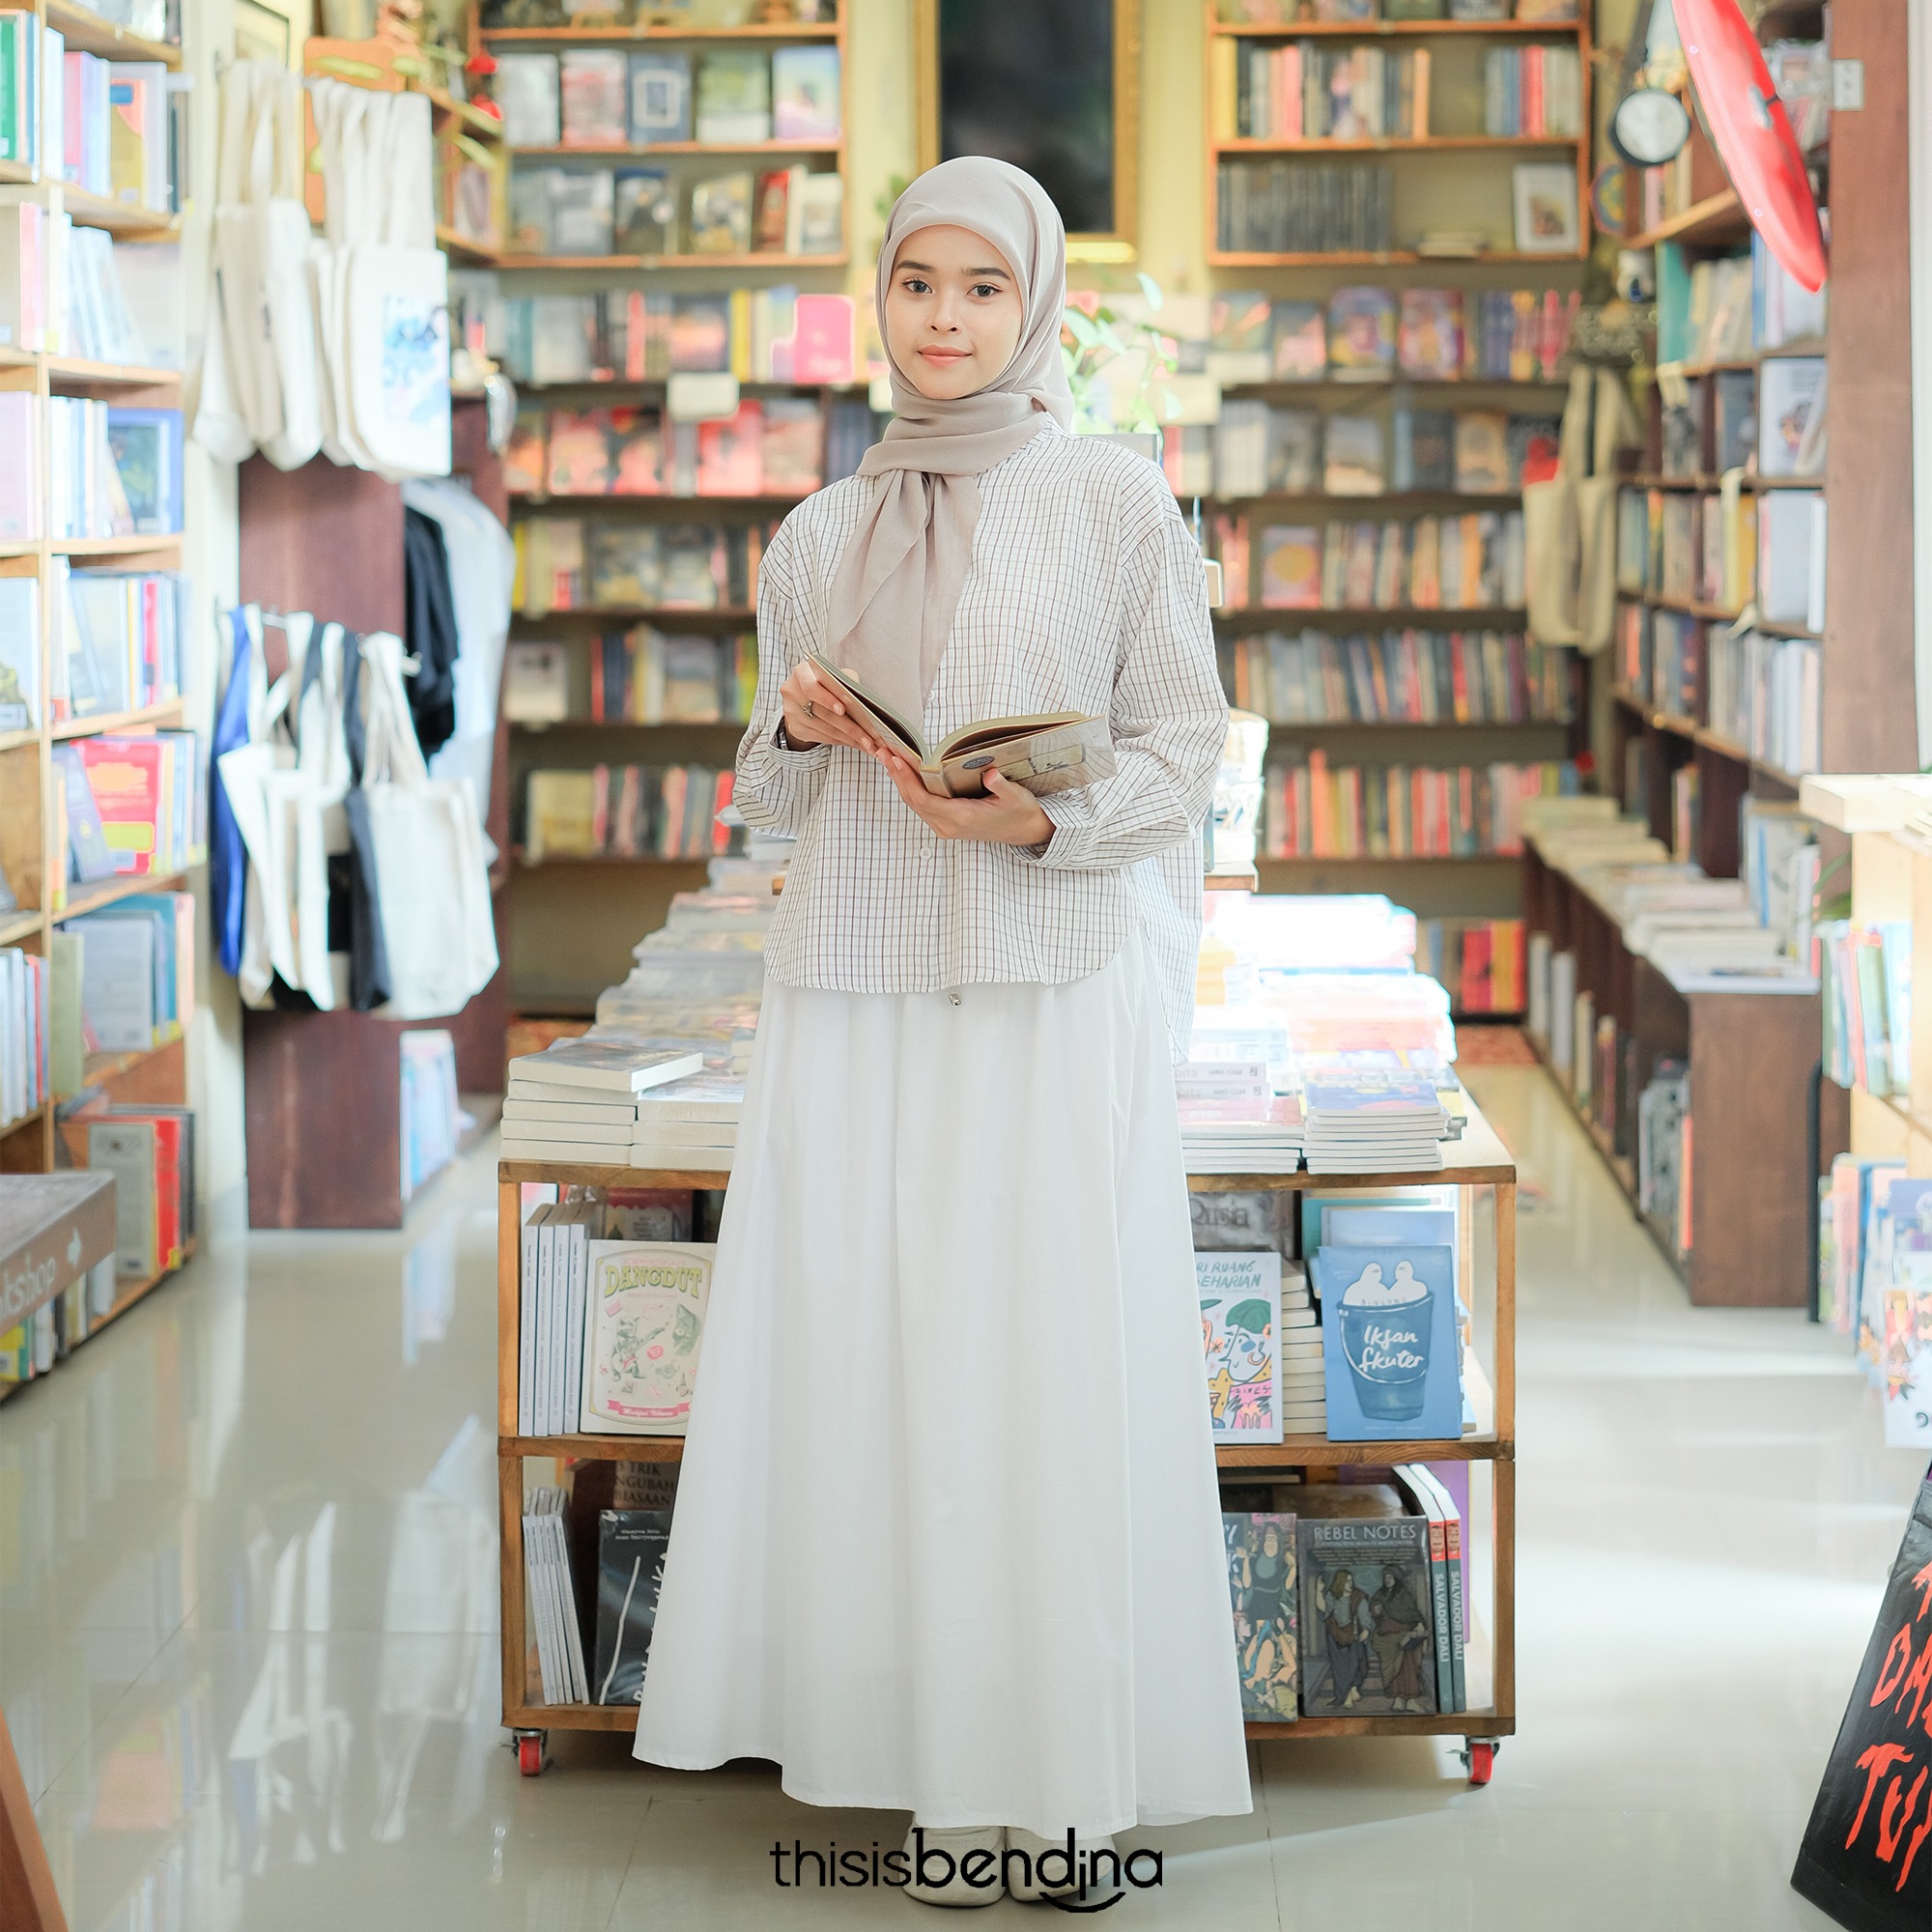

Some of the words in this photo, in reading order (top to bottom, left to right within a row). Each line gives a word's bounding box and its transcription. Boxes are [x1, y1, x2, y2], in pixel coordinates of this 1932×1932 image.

[1211, 1260, 1257, 1273] RUANG
[604, 1265, 702, 1298] DANGDUT
[1197, 1273, 1262, 1289] EHARIAN
[1314, 1526, 1358, 1540] REBEL
[1363, 1525, 1416, 1539] NOTES
[1435, 1574, 1448, 1634] SALVADOR
[1451, 1571, 1463, 1632] SALVADOR
[1438, 1638, 1449, 1662] DALI
[1454, 1634, 1463, 1661] DALI
[1870, 1623, 1932, 1739] DA
